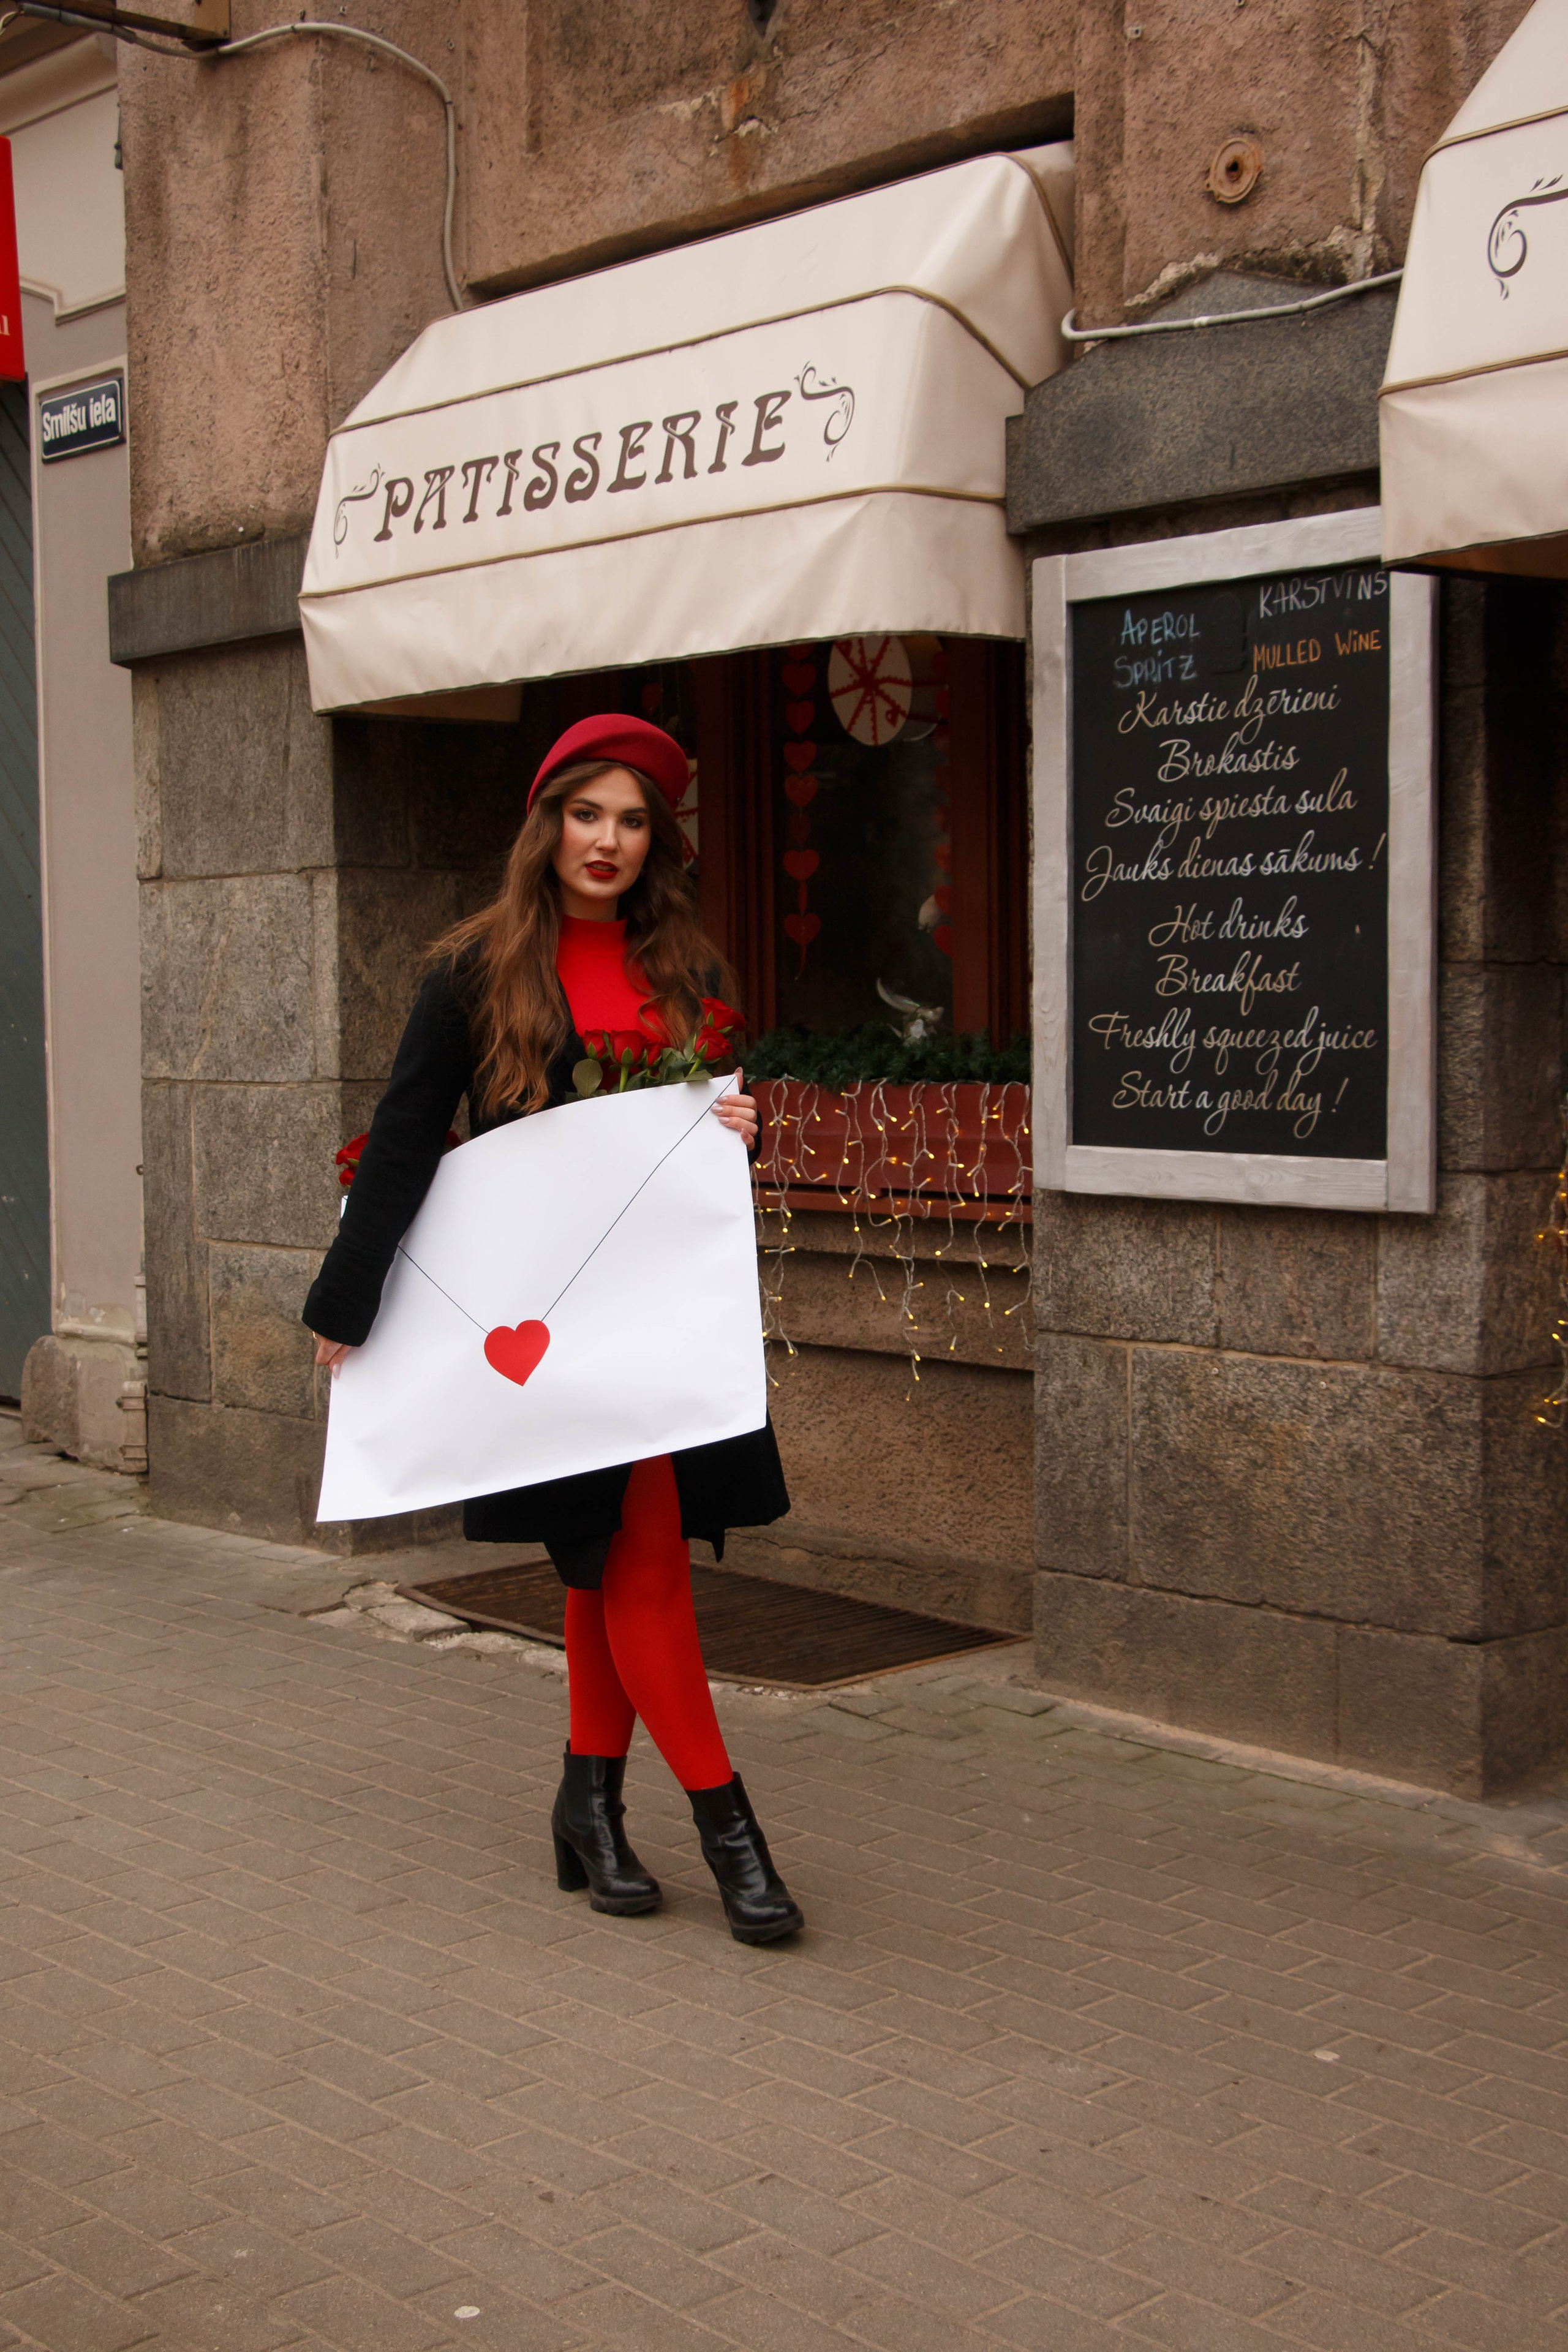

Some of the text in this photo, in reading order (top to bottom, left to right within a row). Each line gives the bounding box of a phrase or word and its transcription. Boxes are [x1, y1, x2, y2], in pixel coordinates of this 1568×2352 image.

[43, 394, 116, 442] Smilšu iela
[373, 390, 793, 543] PATISSERIE
[1121, 609, 1201, 645] APEROL
[1253, 638, 1321, 673] MULLED
[1117, 674, 1341, 745] Karstie dzērieni
[1158, 731, 1301, 782] Brokastis
[1105, 767, 1358, 849] Svaigi spiesta sula
[1080, 837, 1174, 902] Jauks
[1177, 836, 1256, 878] dienas
[1148, 895, 1310, 948] Hot drinks
[1155, 950, 1302, 1017] Breakfast
[1088, 1006, 1378, 1076] Freshly squeezed juice
[1111, 1070, 1193, 1109] Start
[1195, 1090, 1214, 1109] a
[1203, 1068, 1279, 1136] good
